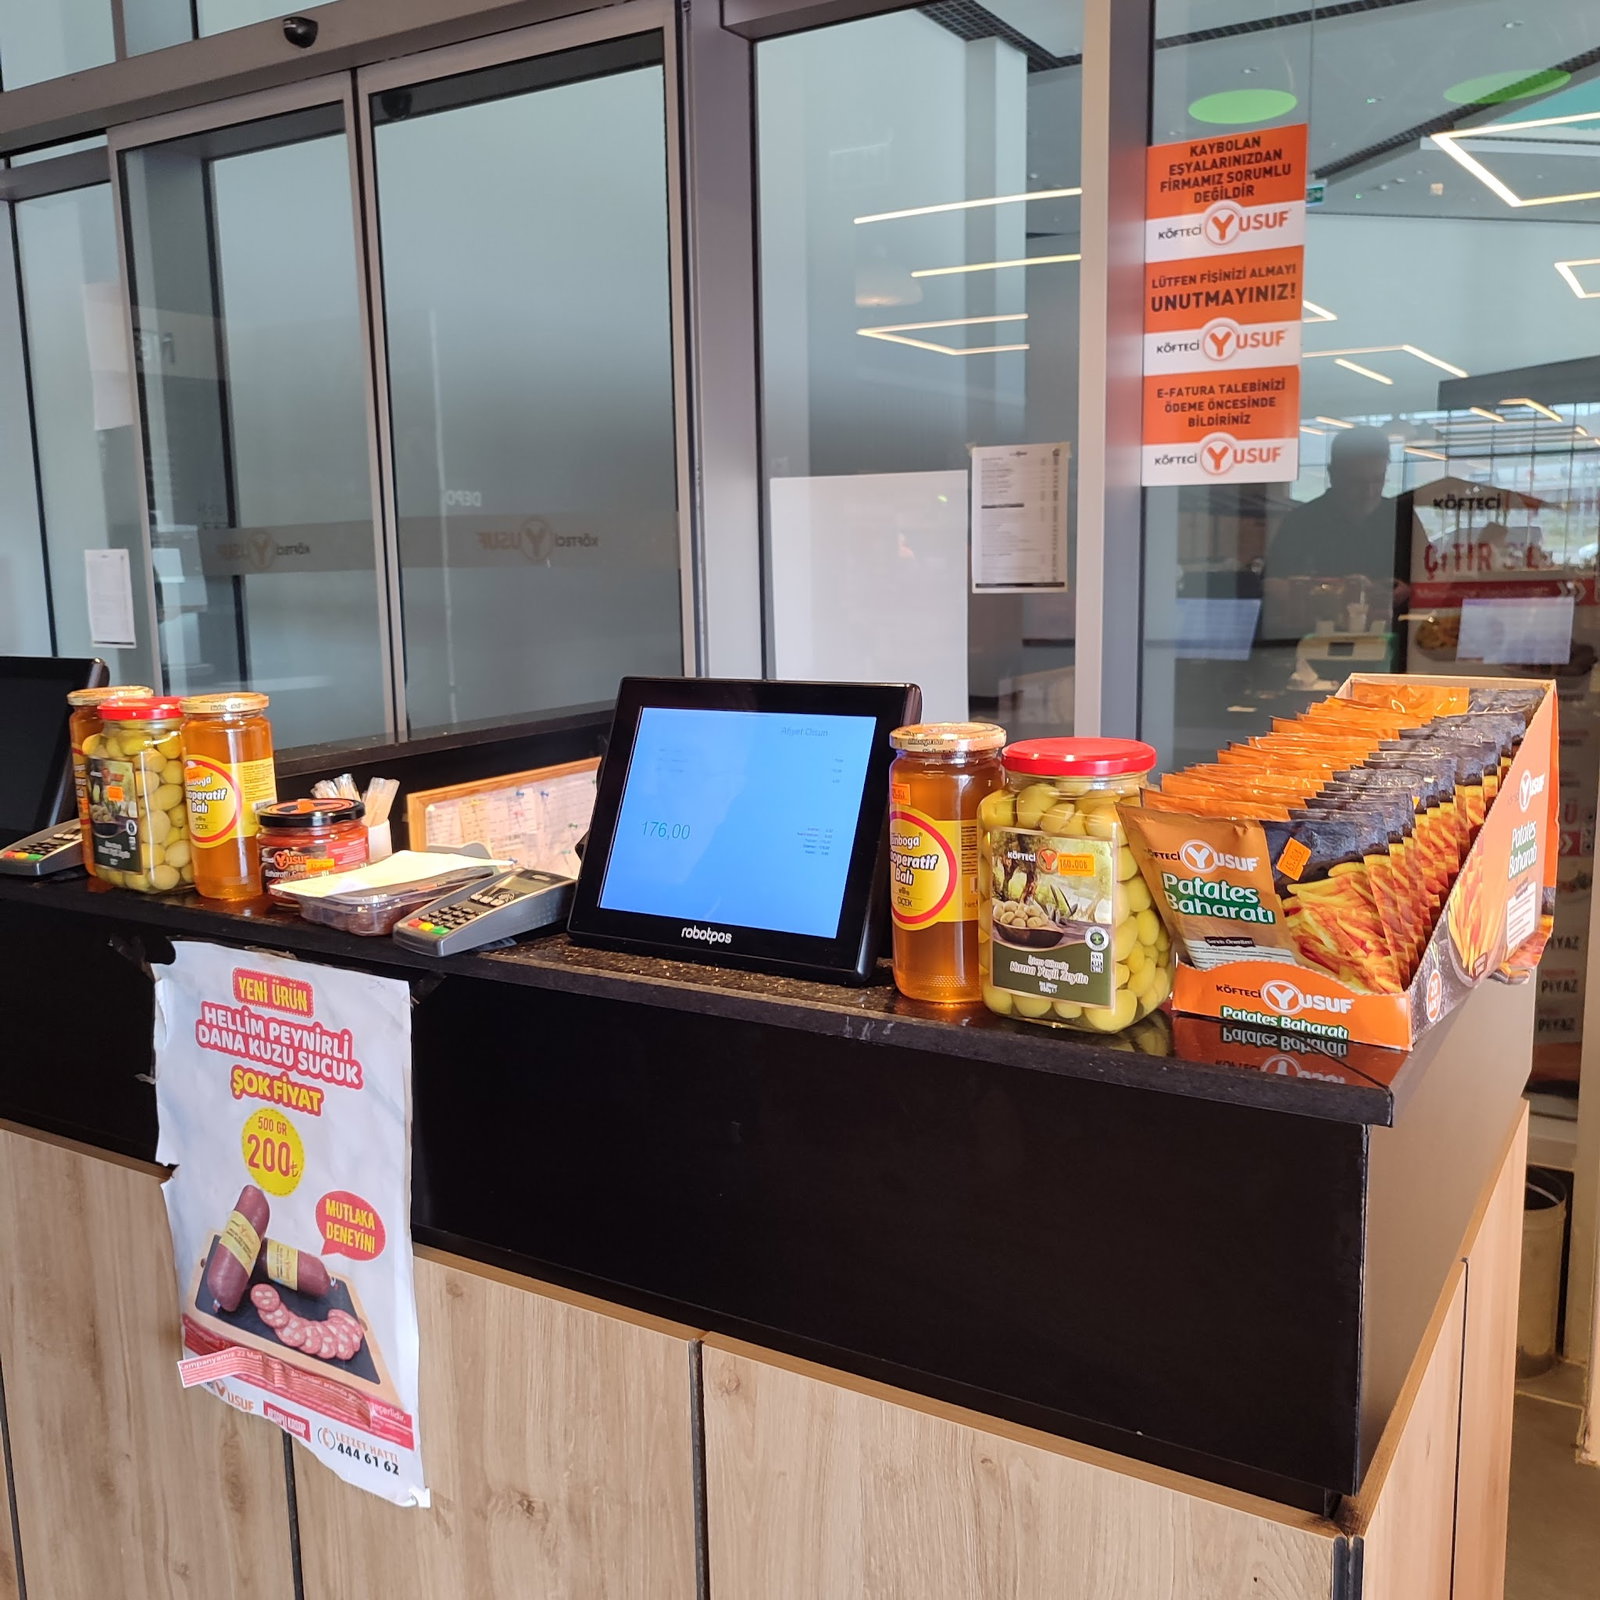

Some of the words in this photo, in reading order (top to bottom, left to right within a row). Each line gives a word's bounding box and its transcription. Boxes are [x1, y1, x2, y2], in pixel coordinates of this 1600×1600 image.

[1168, 149, 1282, 176] EŞYALARINIZDAN
[1189, 136, 1261, 157] KAYBOLAN
[1160, 172, 1224, 193] FİRMAMIZ
[1227, 163, 1292, 185] SORUMLU
[1194, 185, 1255, 203] DEĞİLDİR
[1158, 224, 1202, 240] KÖFTECİ
[1206, 209, 1289, 244] YUSUF
[1152, 274, 1197, 289] LÜTFEN
[1200, 269, 1247, 285] FİŞİNİZİ
[1250, 264, 1296, 279] ALMAYI
[1151, 282, 1296, 312] UNUTMAYINIZ!
[1156, 340, 1200, 354] KÖFTECİ
[1203, 325, 1286, 361] YUSUF
[1157, 384, 1216, 399] E-FATURA
[1218, 377, 1286, 393] TALEBİNİZİ
[1164, 400, 1205, 413] ÖDEME
[1207, 396, 1276, 411] ÖNCESİNDE
[1188, 414, 1251, 427] BİLDİRİNİZ
[1154, 453, 1198, 466] KÖFTECİ
[1201, 440, 1282, 475] YUSUF
[641, 821, 691, 840] 176,00
[1181, 839, 1259, 873] YUSUF
[1162, 872, 1259, 904] Patates
[1164, 890, 1274, 923] Baharatı
[681, 925, 733, 944] robotpos
[238, 976, 268, 1003] YENİ
[272, 978, 308, 1011] ÜRÜN
[1215, 984, 1262, 999] KÖFTECİ
[1262, 979, 1353, 1015] YUSUF
[204, 1006, 265, 1036] HELLİM
[269, 1022, 350, 1060] PEYNİRLİ
[1222, 1006, 1278, 1027] Patates
[1280, 1016, 1348, 1040] Baharatı
[199, 1026, 245, 1053] DANA
[249, 1038, 294, 1066] KUZU
[297, 1052, 360, 1084] SUCUK
[233, 1069, 271, 1097] ŞOK
[273, 1077, 321, 1112] FİYAT
[258, 1116, 274, 1132] 500
[276, 1120, 287, 1135] GR
[325, 1199, 375, 1231] MUTLAKA
[326, 1222, 375, 1255] DENEYİN!
[337, 1443, 360, 1460] 444
[364, 1453, 379, 1468] 61
[383, 1460, 400, 1476] 62
